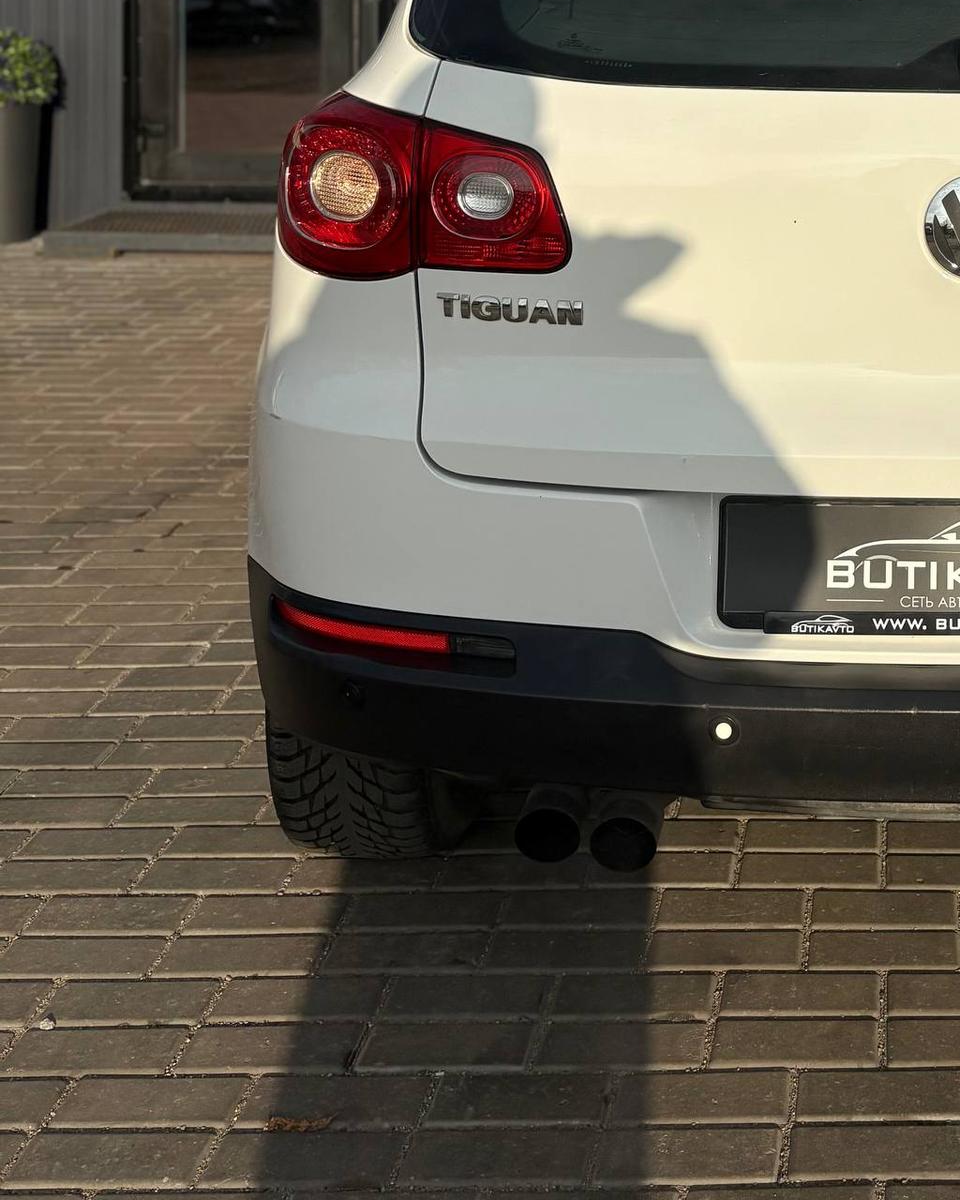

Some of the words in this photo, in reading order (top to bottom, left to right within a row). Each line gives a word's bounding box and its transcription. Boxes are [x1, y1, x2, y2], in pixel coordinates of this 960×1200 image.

[436, 292, 584, 326] TIGUAN
[900, 596, 934, 608] СЕТЬ
[790, 623, 855, 634] BUTIKAVTO
[872, 618, 928, 631] WWW.
